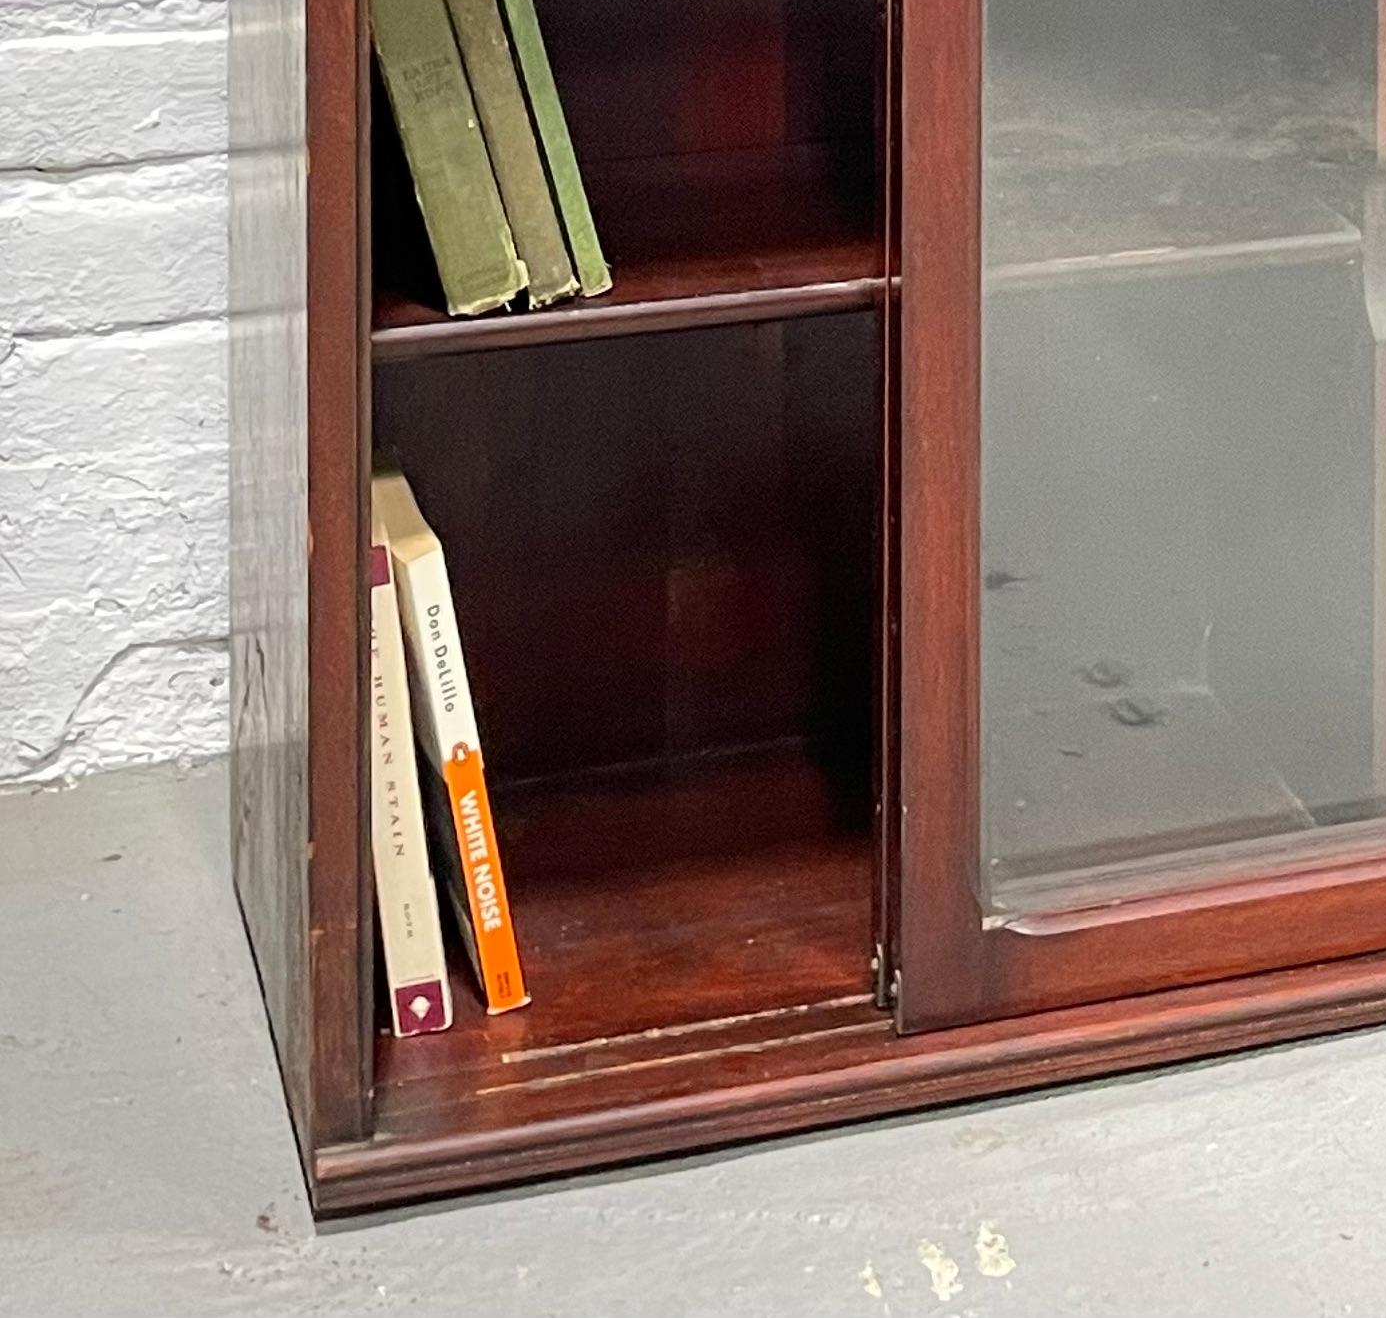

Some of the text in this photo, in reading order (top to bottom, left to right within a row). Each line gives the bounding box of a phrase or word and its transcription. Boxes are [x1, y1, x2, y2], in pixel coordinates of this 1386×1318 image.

[427, 603, 458, 713] Don DeLillo
[374, 674, 394, 765] HUMAN
[386, 780, 405, 856] STAIN
[459, 789, 503, 933] WHITE NOISE
